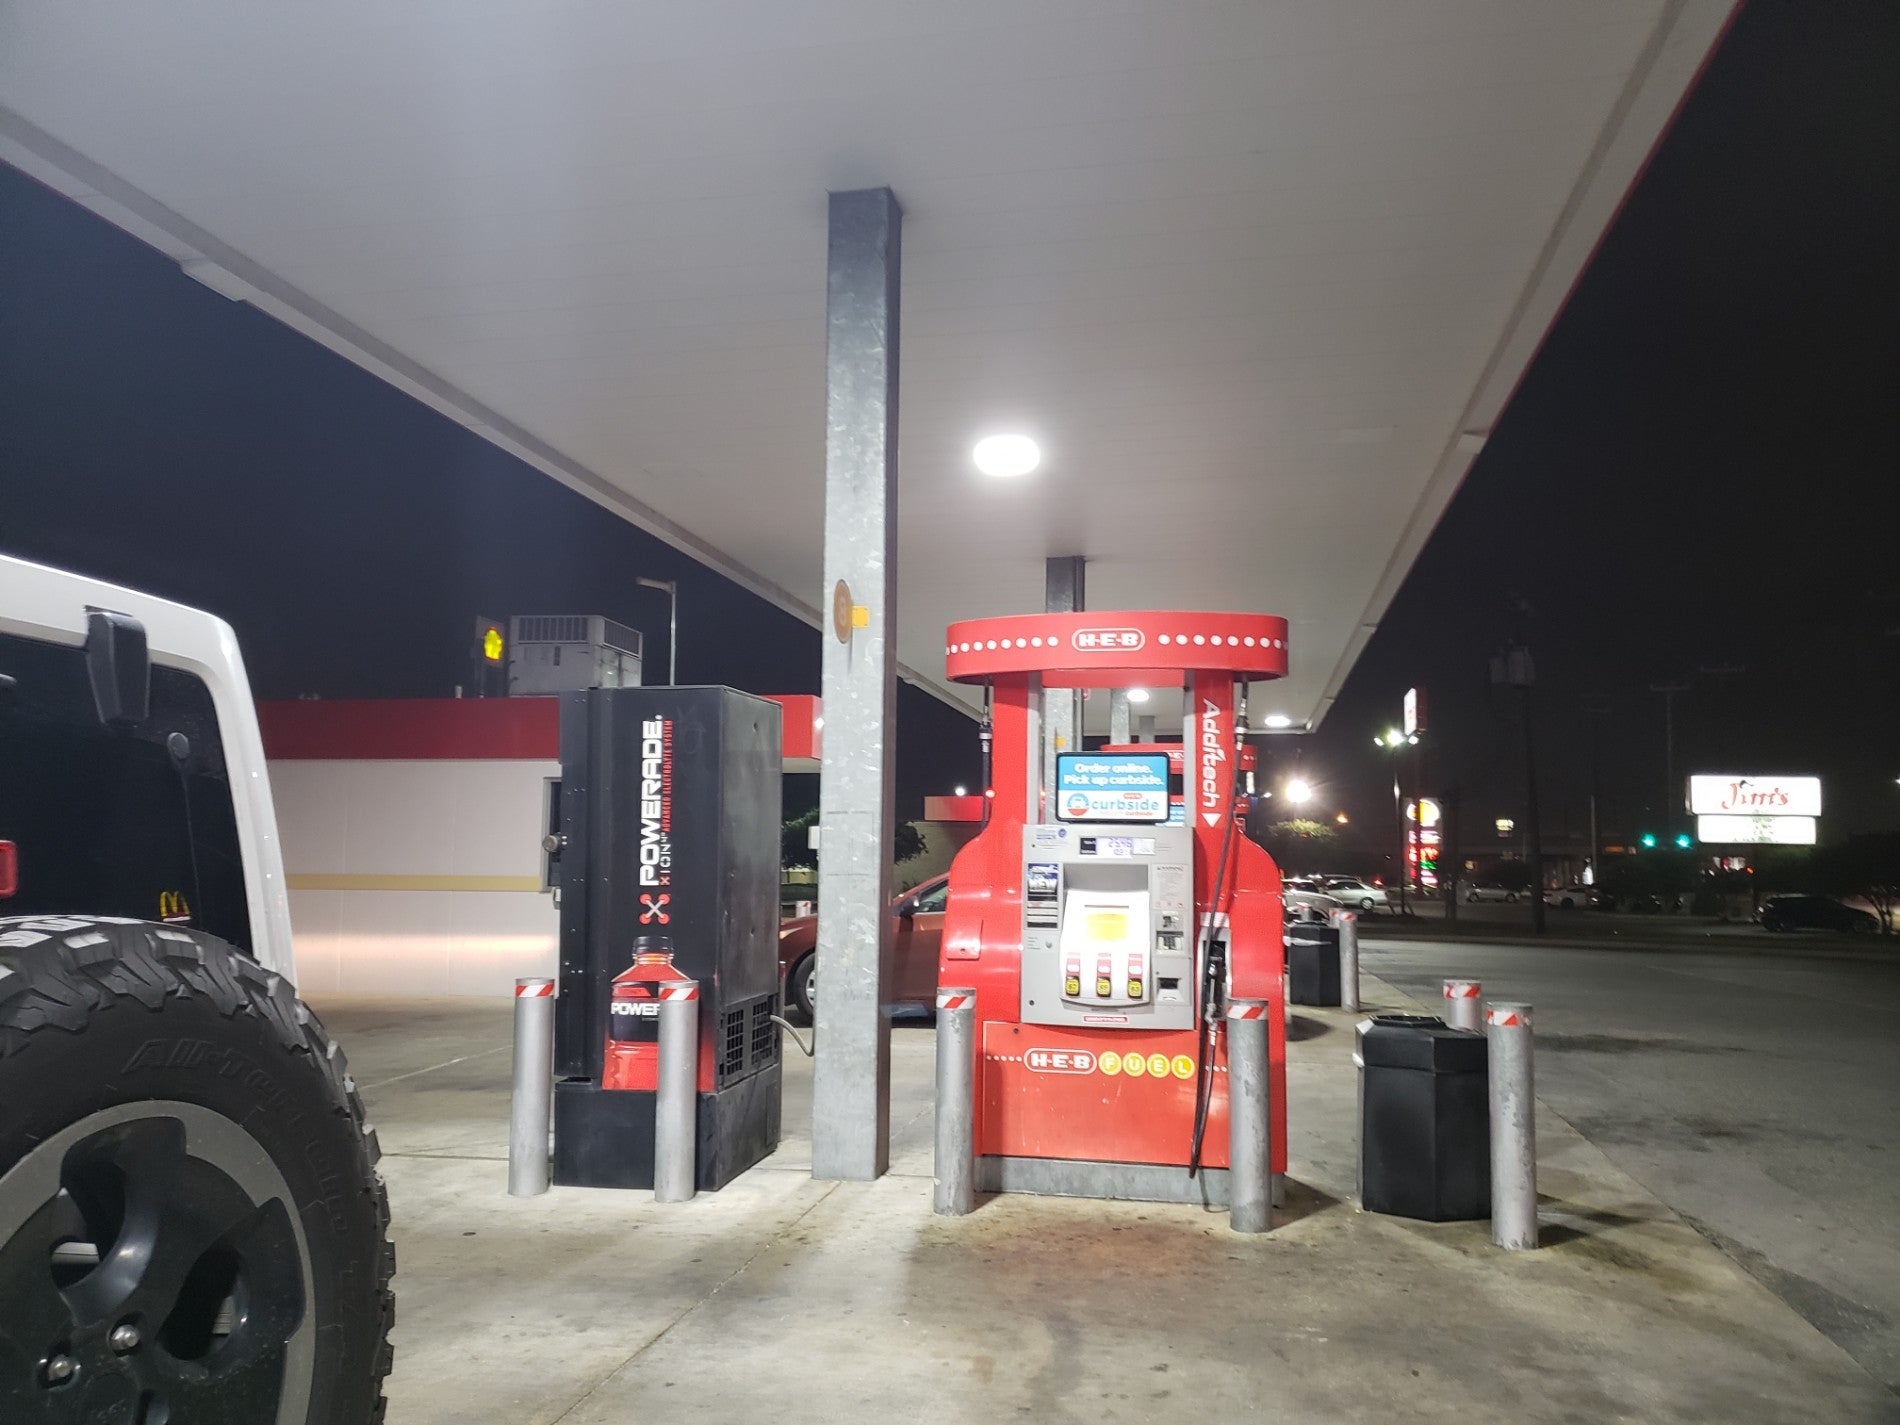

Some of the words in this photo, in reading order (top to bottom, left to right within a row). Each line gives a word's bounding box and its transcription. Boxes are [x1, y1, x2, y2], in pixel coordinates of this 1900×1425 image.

[1078, 632, 1139, 648] H-E-B
[664, 720, 673, 747] SYSTEM
[1202, 698, 1225, 808] Additech
[1074, 763, 1110, 774] Order
[1112, 763, 1153, 774] online.
[1063, 774, 1090, 785] Pick
[1091, 776, 1108, 787] up
[1109, 775, 1164, 785] curbside.
[640, 719, 662, 886] POWERADE
[1721, 780, 1788, 810] Jim's
[1091, 799, 1160, 811] curbside
[610, 1003, 660, 1016] POWER
[1030, 1053, 1091, 1070] H-E-B
[1105, 1057, 1188, 1074] FUEL
